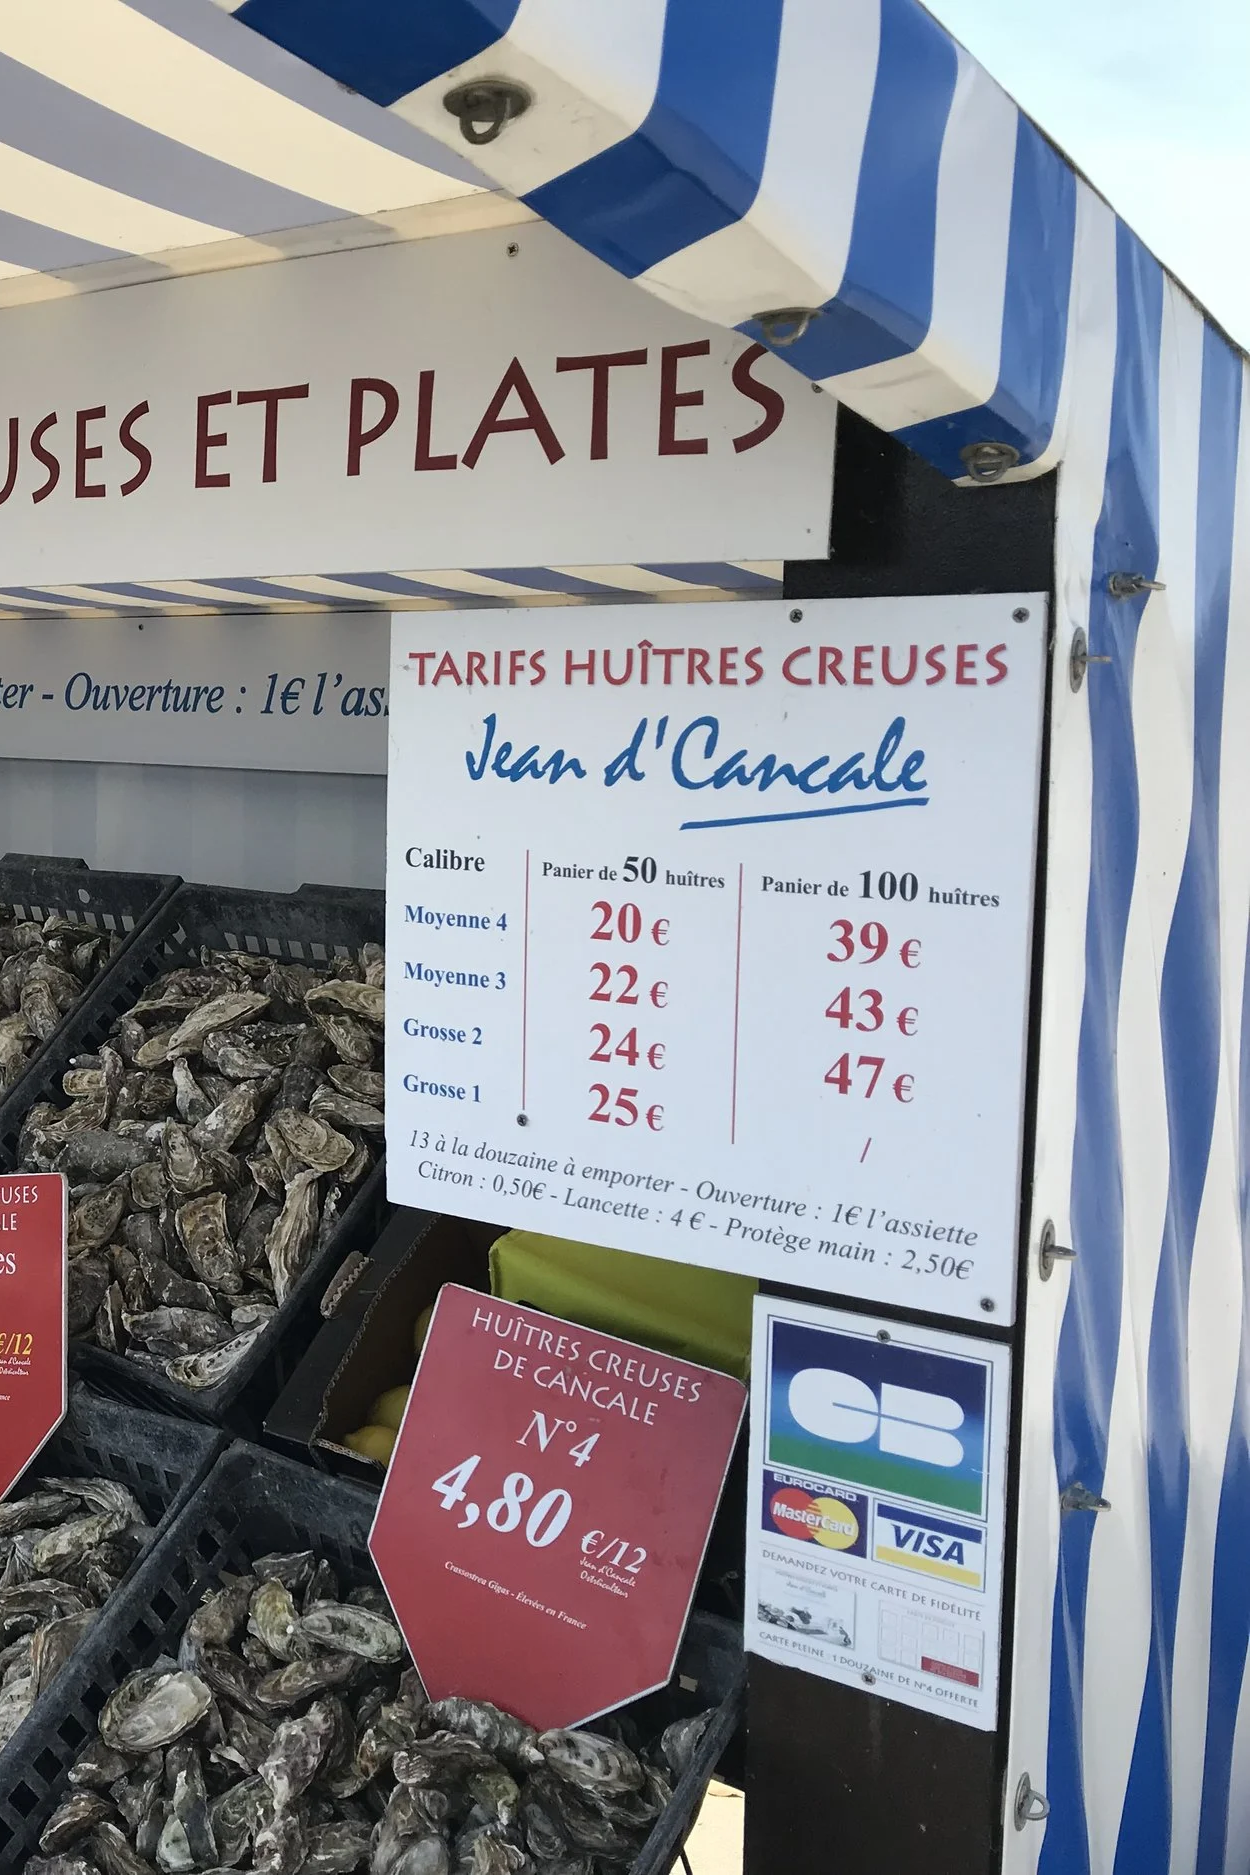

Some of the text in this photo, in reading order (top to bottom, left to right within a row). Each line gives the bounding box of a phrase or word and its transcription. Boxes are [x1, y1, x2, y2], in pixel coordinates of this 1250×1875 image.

[195, 383, 309, 488] ET
[347, 340, 786, 477] PLATES
[409, 640, 1009, 687] TARIFS HUÎTRES CREUSES
[64, 672, 224, 713] Ouverture
[260, 673, 305, 715] 1€
[466, 713, 929, 794] Jean d'Cancale
[405, 847, 1001, 908] Calibre Panier de 50 huîtres Panier de 100 huîtres
[404, 905, 508, 932] Moyenne 4
[590, 900, 671, 947] 20 €
[826, 919, 922, 970] 39 €
[404, 961, 507, 991] Moyenne 3
[589, 962, 669, 1009] 22 €
[403, 1018, 483, 1046] Grosse 2
[824, 986, 919, 1037] 43 €
[588, 1023, 667, 1071] 24 €
[403, 1073, 481, 1103] Grosse 1
[823, 1052, 916, 1105] 47 €
[587, 1083, 665, 1131] 25 €
[410, 1130, 978, 1246] 13 à la douzaine à emporter Ouverture 1€ l'assiette
[418, 1160, 473, 1187] Citron
[492, 1174, 546, 1201] 0,50€
[563, 1188, 649, 1222] Lancette
[670, 1209, 683, 1228] 4
[724, 1217, 812, 1254] Protège
[817, 1239, 876, 1264] main
[901, 1249, 975, 1280] 2,50€
[471, 1306, 702, 1403] HUÎTRES CREUSES
[493, 1348, 659, 1426] DE CANCALE
[788, 1367, 965, 1467] CB
[773, 1473, 858, 1502] EUROCARD
[431, 1454, 648, 1575] 4,80 €/12
[773, 1501, 856, 1537] MasterCard
[579, 1556, 597, 1571] Jean
[891, 1523, 965, 1565] VISA
[444, 1560, 587, 1630] Crassostrea Gigas Élevées en France
[762, 1550, 827, 1575] DEMANDEZ
[830, 1569, 867, 1588] VOTRE
[870, 1581, 907, 1600] CARTE
[912, 1593, 928, 1605] DE
[759, 1631, 790, 1646] CARTE
[792, 1641, 824, 1657] PLEINE
[839, 1656, 894, 1680] DOUZAINE
[898, 1675, 910, 1685] DE
[935, 1687, 979, 1708] OFFERTE
